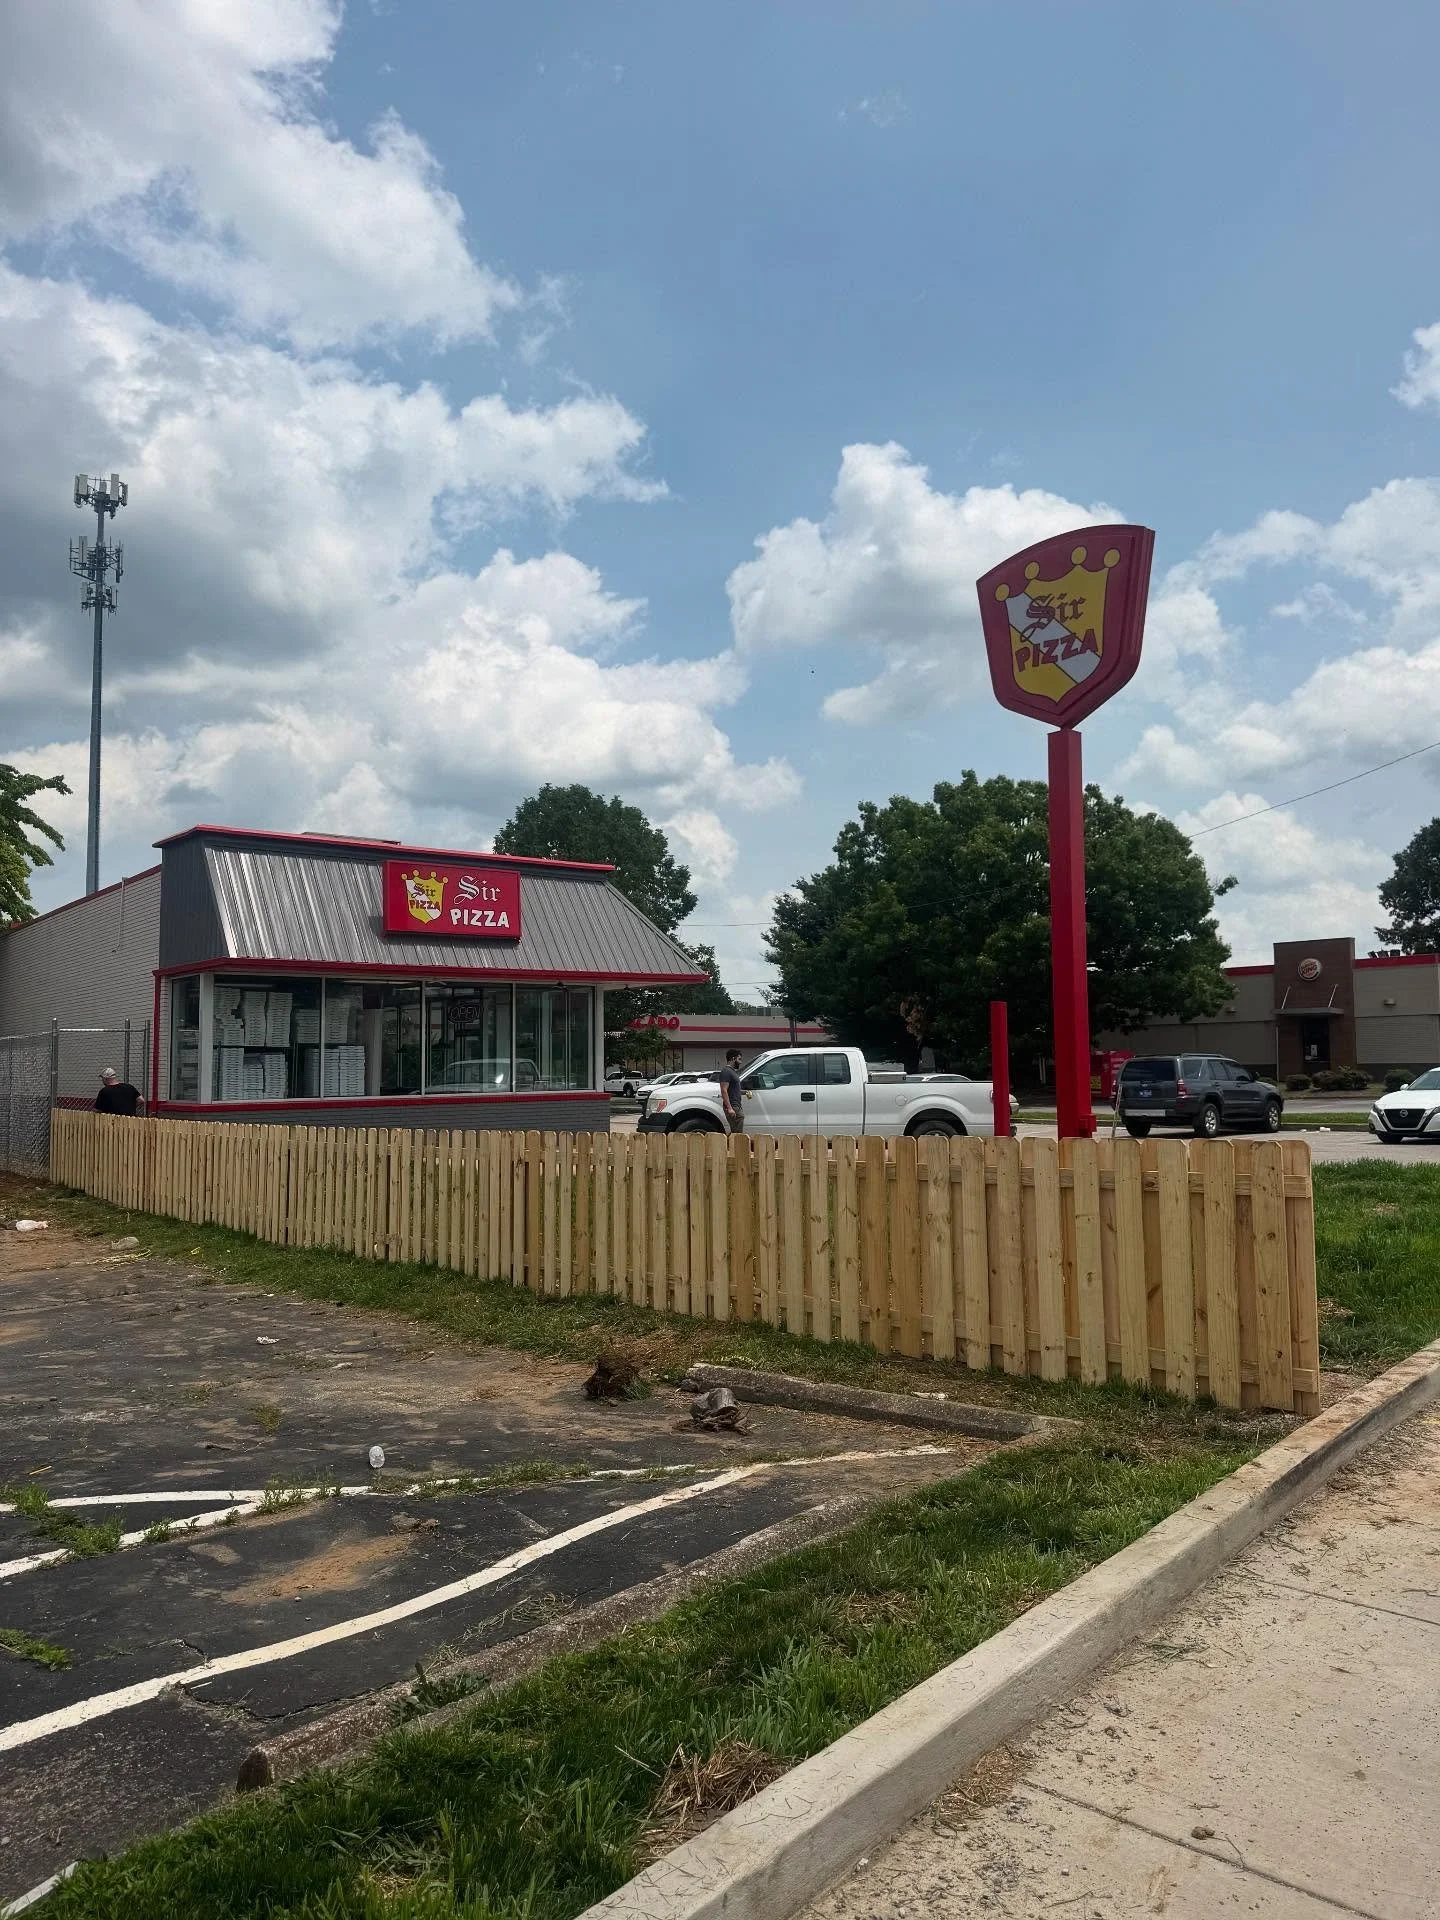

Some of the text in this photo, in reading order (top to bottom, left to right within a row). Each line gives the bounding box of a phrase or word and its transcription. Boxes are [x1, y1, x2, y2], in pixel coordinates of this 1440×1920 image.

[1022, 593, 1085, 642] Sir
[1015, 628, 1098, 672] PIZZA
[411, 883, 436, 898] Sir
[453, 875, 501, 905] Sir
[409, 899, 441, 911] PIZZA
[450, 908, 510, 929] PIZZA
[451, 1005, 481, 1019] OPEN
